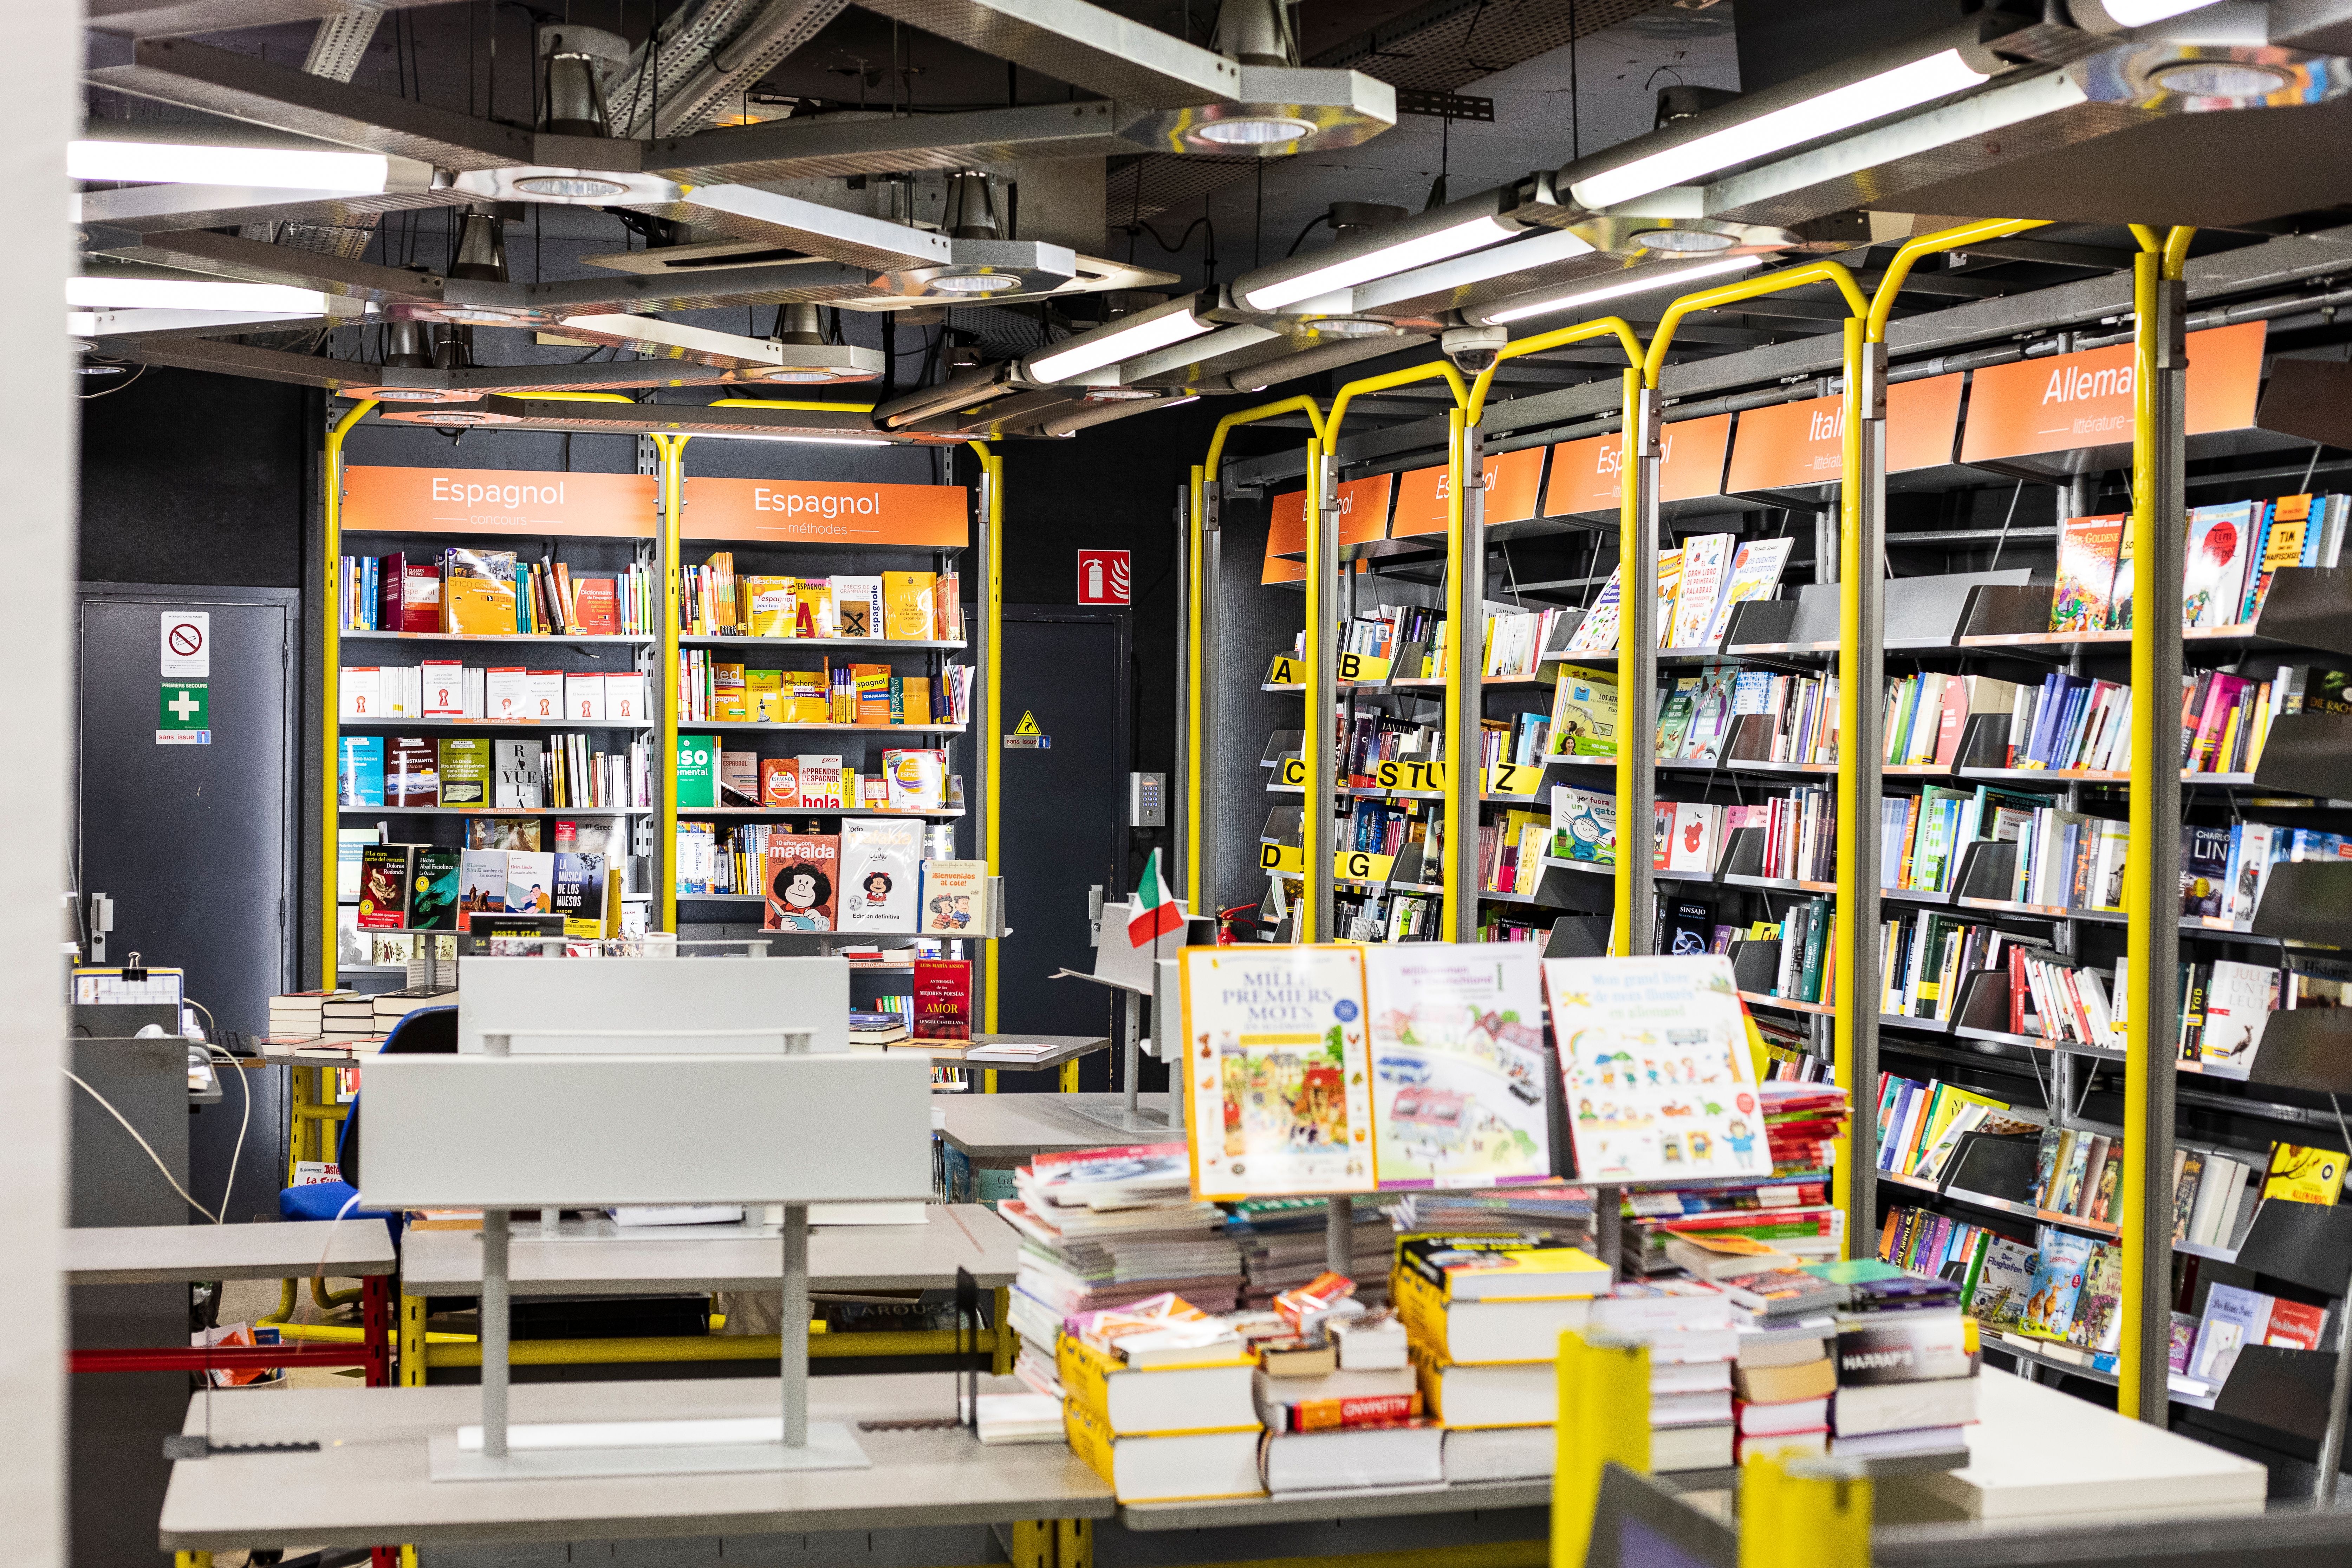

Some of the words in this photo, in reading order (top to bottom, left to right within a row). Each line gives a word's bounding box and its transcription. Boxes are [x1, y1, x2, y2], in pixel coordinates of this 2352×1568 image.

[2043, 365, 2135, 405] Allema
[2073, 416, 2124, 435] littérature
[1813, 454, 1843, 470] littératu
[433, 477, 564, 508] Espagnol
[755, 488, 879, 519] Espagnol
[470, 514, 527, 526] concours
[789, 523, 847, 535] méthodes
[2085, 532, 2119, 544] GOLDENE
[2280, 530, 2295, 544] TIM
[1755, 556, 1776, 564] CUENTOS
[1702, 568, 1716, 576] LIBRO
[1750, 565, 1776, 573] DIVERTIDOS
[449, 579, 472, 588] cinco
[1687, 586, 1712, 594] PALABRAS
[758, 596, 793, 604] l'espagnol
[871, 585, 880, 633] espagnole
[1275, 659, 1292, 684] A
[1341, 654, 1360, 678] B
[1709, 700, 1715, 708] EL
[1704, 709, 1716, 717] LIBRO
[1381, 722, 1414, 735] JAVIER
[1696, 727, 1715, 735] SALUDOS
[1286, 761, 1304, 784] C
[1379, 763, 1398, 787] S
[1407, 763, 1424, 788] T
[1495, 765, 1516, 792] Z
[826, 783, 839, 795] A2
[803, 795, 839, 808] hola
[1590, 797, 1609, 806] fuera
[1595, 807, 1616, 816] gato
[770, 844, 835, 859] mafalda
[1262, 845, 1281, 868] D
[559, 859, 567, 870] LA
[1349, 854, 1370, 878] G
[559, 870, 582, 883] MÚSICA
[558, 884, 566, 895] DE
[567, 883, 579, 895] LOS
[557, 896, 581, 907] HUESOS
[1679, 906, 1705, 915] SINSAJO
[1222, 989, 1333, 1005] PREMIERS
[925, 1003, 958, 1014] AMOR
[1247, 1006, 1313, 1021] MOTS
[2002, 1253, 2013, 1262] Der
[1987, 1255, 2022, 1275] Flughafen
